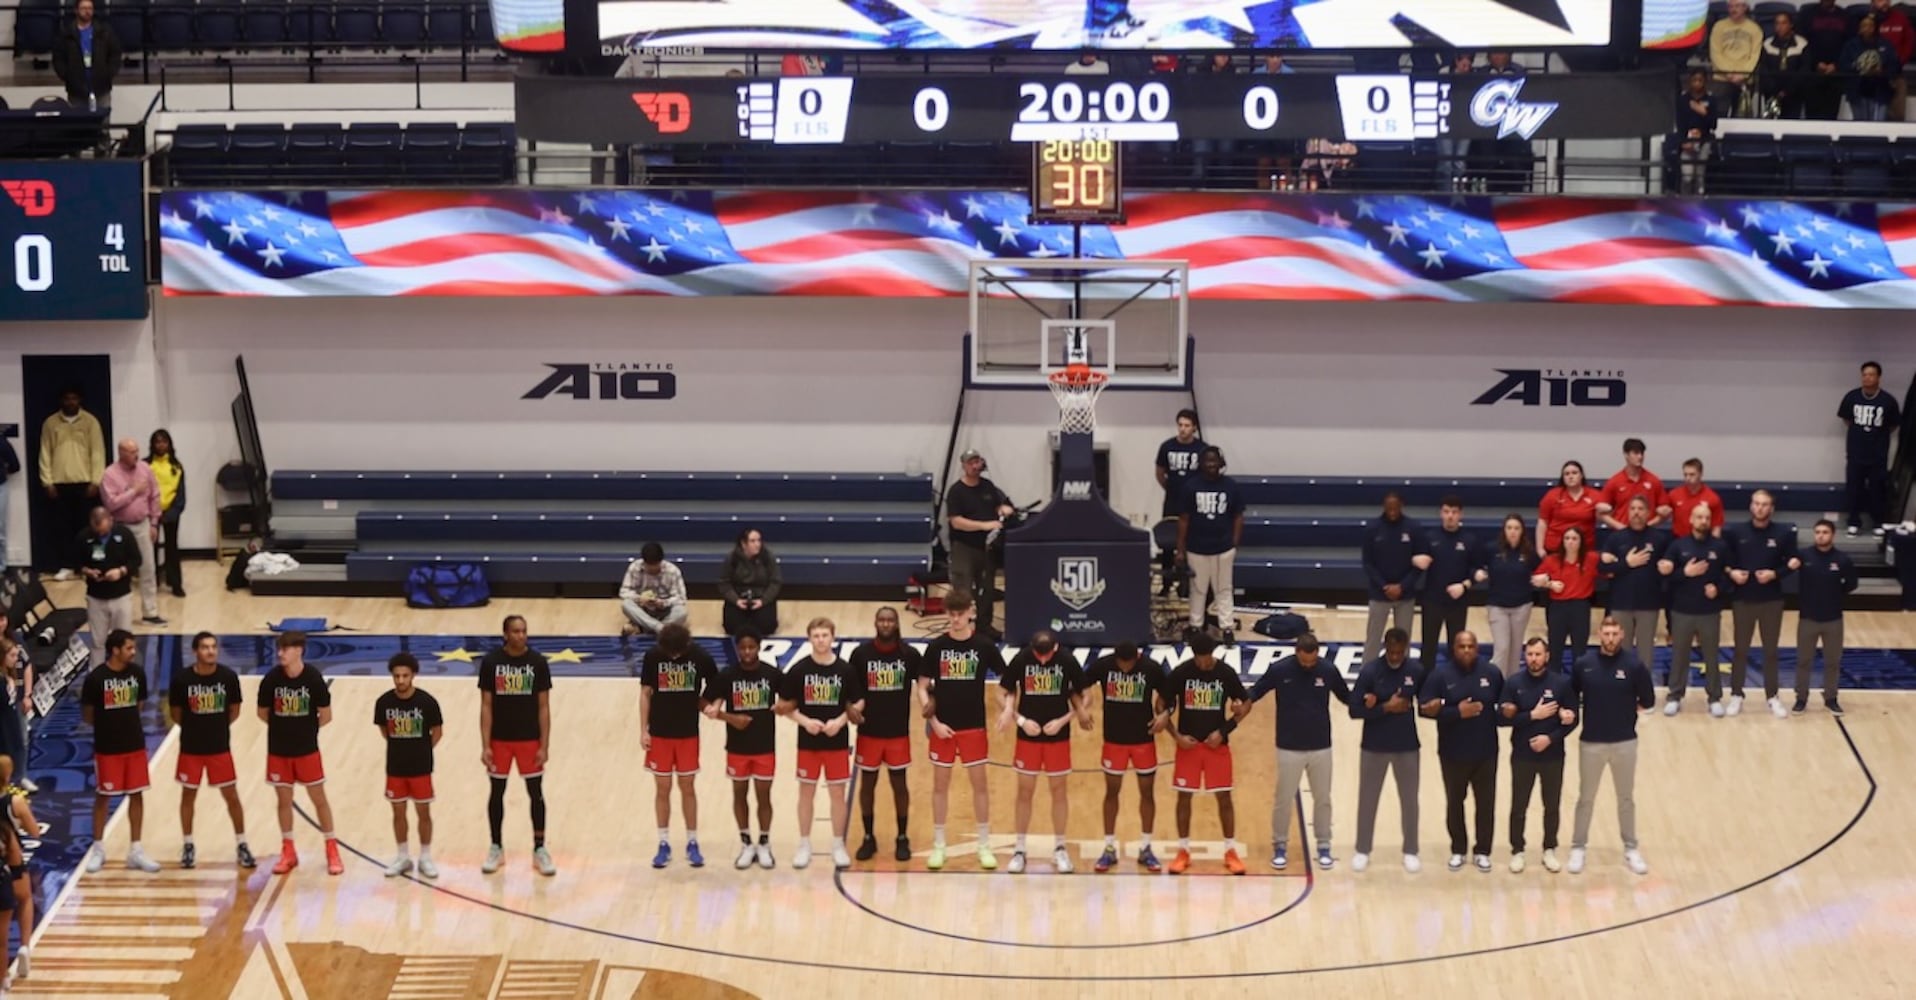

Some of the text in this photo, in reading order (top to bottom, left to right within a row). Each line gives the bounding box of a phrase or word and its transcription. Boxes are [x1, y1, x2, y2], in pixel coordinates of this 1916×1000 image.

[601, 45, 704, 56] DAKTRONICS
[799, 88, 823, 116] 0
[1019, 82, 1170, 122] 20:00
[1367, 86, 1391, 114] 0
[914, 88, 949, 131] 0
[1244, 86, 1279, 130] 0
[1043, 140, 1112, 162] 20:00
[1053, 165, 1104, 206] 30
[104, 223, 125, 251] 4
[14, 234, 54, 291] 0
[99, 255, 131, 272] TOL
[520, 363, 676, 400] A10
[1469, 369, 1627, 406] A10
[1063, 561, 1094, 592] 50
[1063, 620, 1105, 631] VANDA
[940, 649, 979, 661] Black
[495, 664, 535, 676] Black
[658, 661, 696, 673] Black
[867, 660, 906, 671] Black
[1025, 664, 1063, 676] Black
[104, 676, 139, 690] Black
[732, 678, 770, 692] Black
[804, 673, 842, 686] Black
[1106, 671, 1146, 685] Black
[188, 683, 226, 697] Black
[274, 686, 310, 698] Black
[1185, 679, 1224, 692] Black
[386, 707, 423, 719] Black
